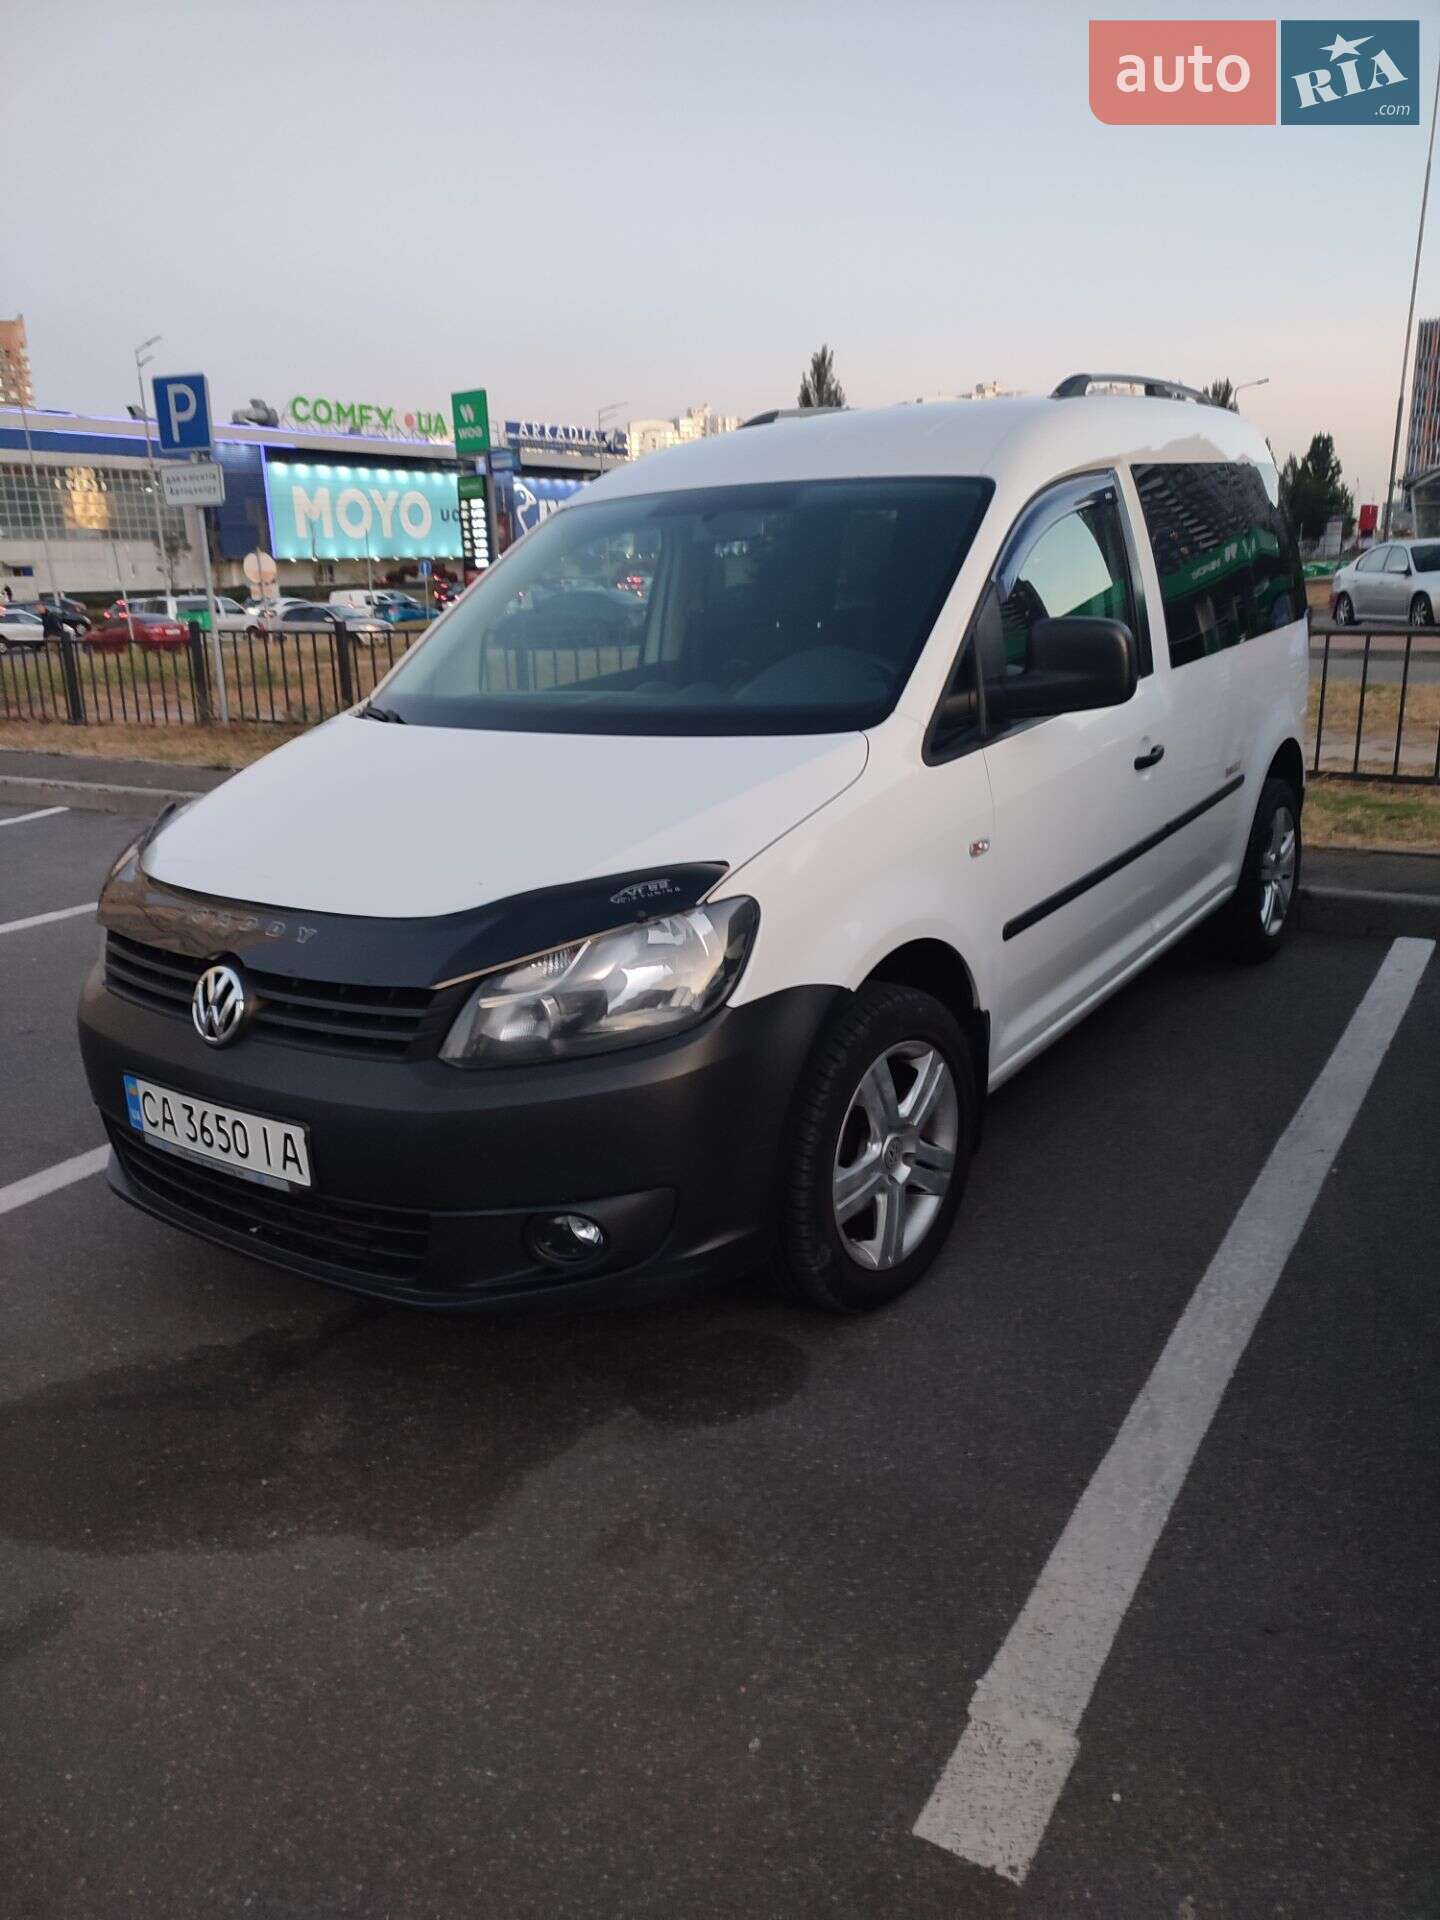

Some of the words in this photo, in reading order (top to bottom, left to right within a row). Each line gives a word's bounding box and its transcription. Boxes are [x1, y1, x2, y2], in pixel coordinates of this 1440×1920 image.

[166, 383, 197, 443] P
[518, 421, 601, 446] ARKADIA
[291, 485, 433, 539] MOYO
[142, 1091, 178, 1137] CA
[182, 1103, 249, 1160] 3650
[262, 1126, 303, 1175] IA
